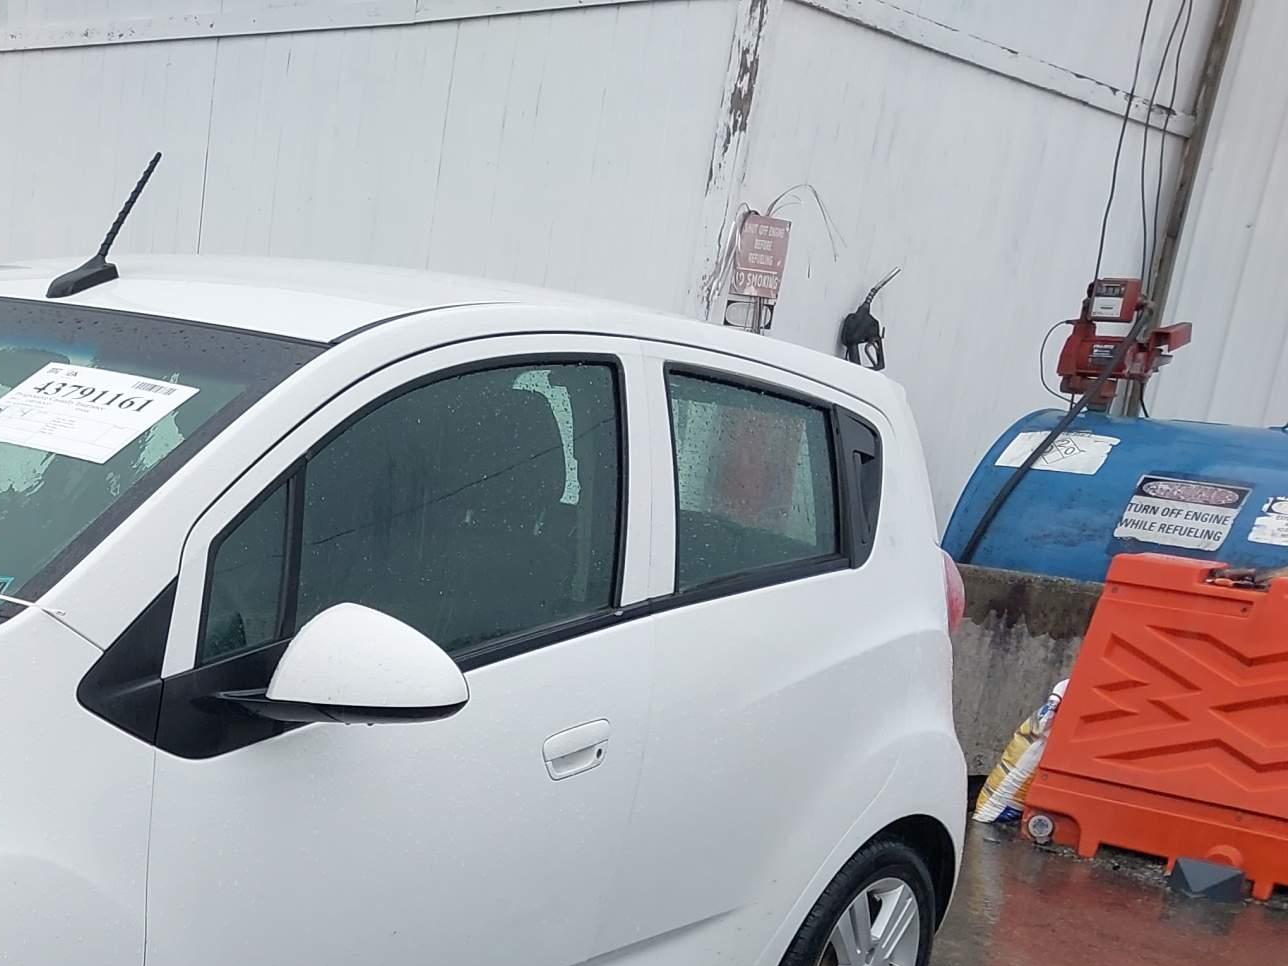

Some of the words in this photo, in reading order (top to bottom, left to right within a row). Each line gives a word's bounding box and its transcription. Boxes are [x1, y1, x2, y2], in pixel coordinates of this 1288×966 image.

[33, 380, 155, 412] 43791161
[1128, 503, 1159, 515] TURN
[1160, 507, 1183, 519] OFF
[1184, 510, 1232, 526] ENGINE
[1119, 518, 1157, 531] WHILE
[1157, 522, 1223, 541] REFUELING
